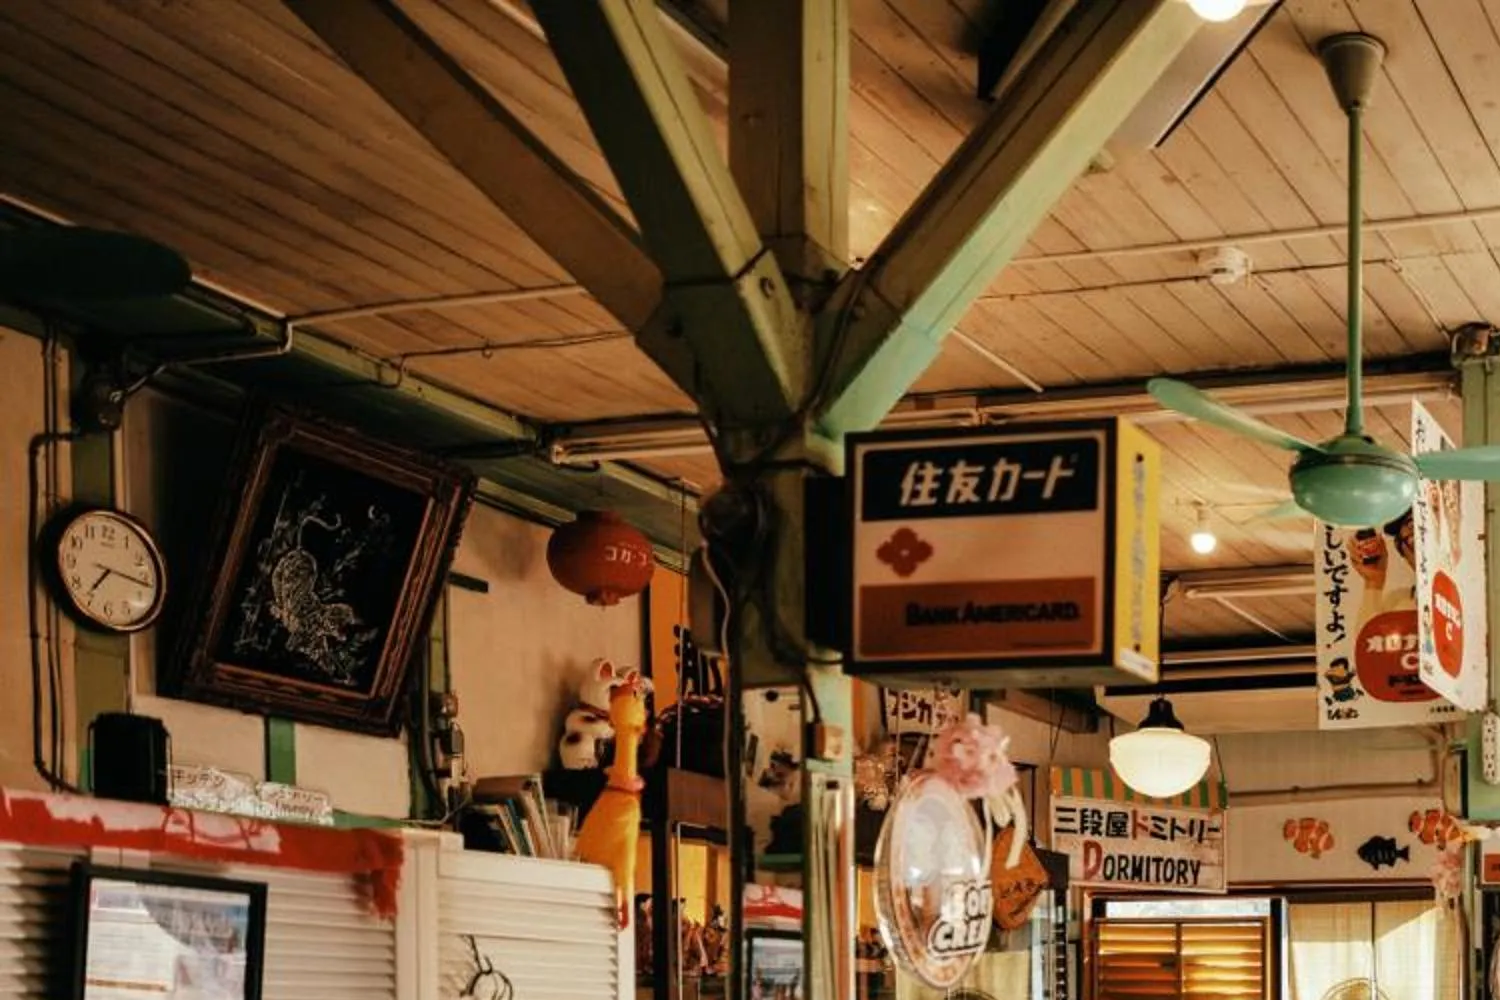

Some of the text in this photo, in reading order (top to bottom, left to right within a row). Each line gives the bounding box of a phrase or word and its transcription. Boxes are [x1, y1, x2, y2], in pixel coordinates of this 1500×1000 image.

[899, 454, 1076, 507] 住友カード
[102, 525, 115, 540] 12
[1366, 634, 1418, 653] オロナ
[1054, 806, 1221, 844] 三段屋ドミトリー
[1082, 839, 1202, 885] DORMITORY
